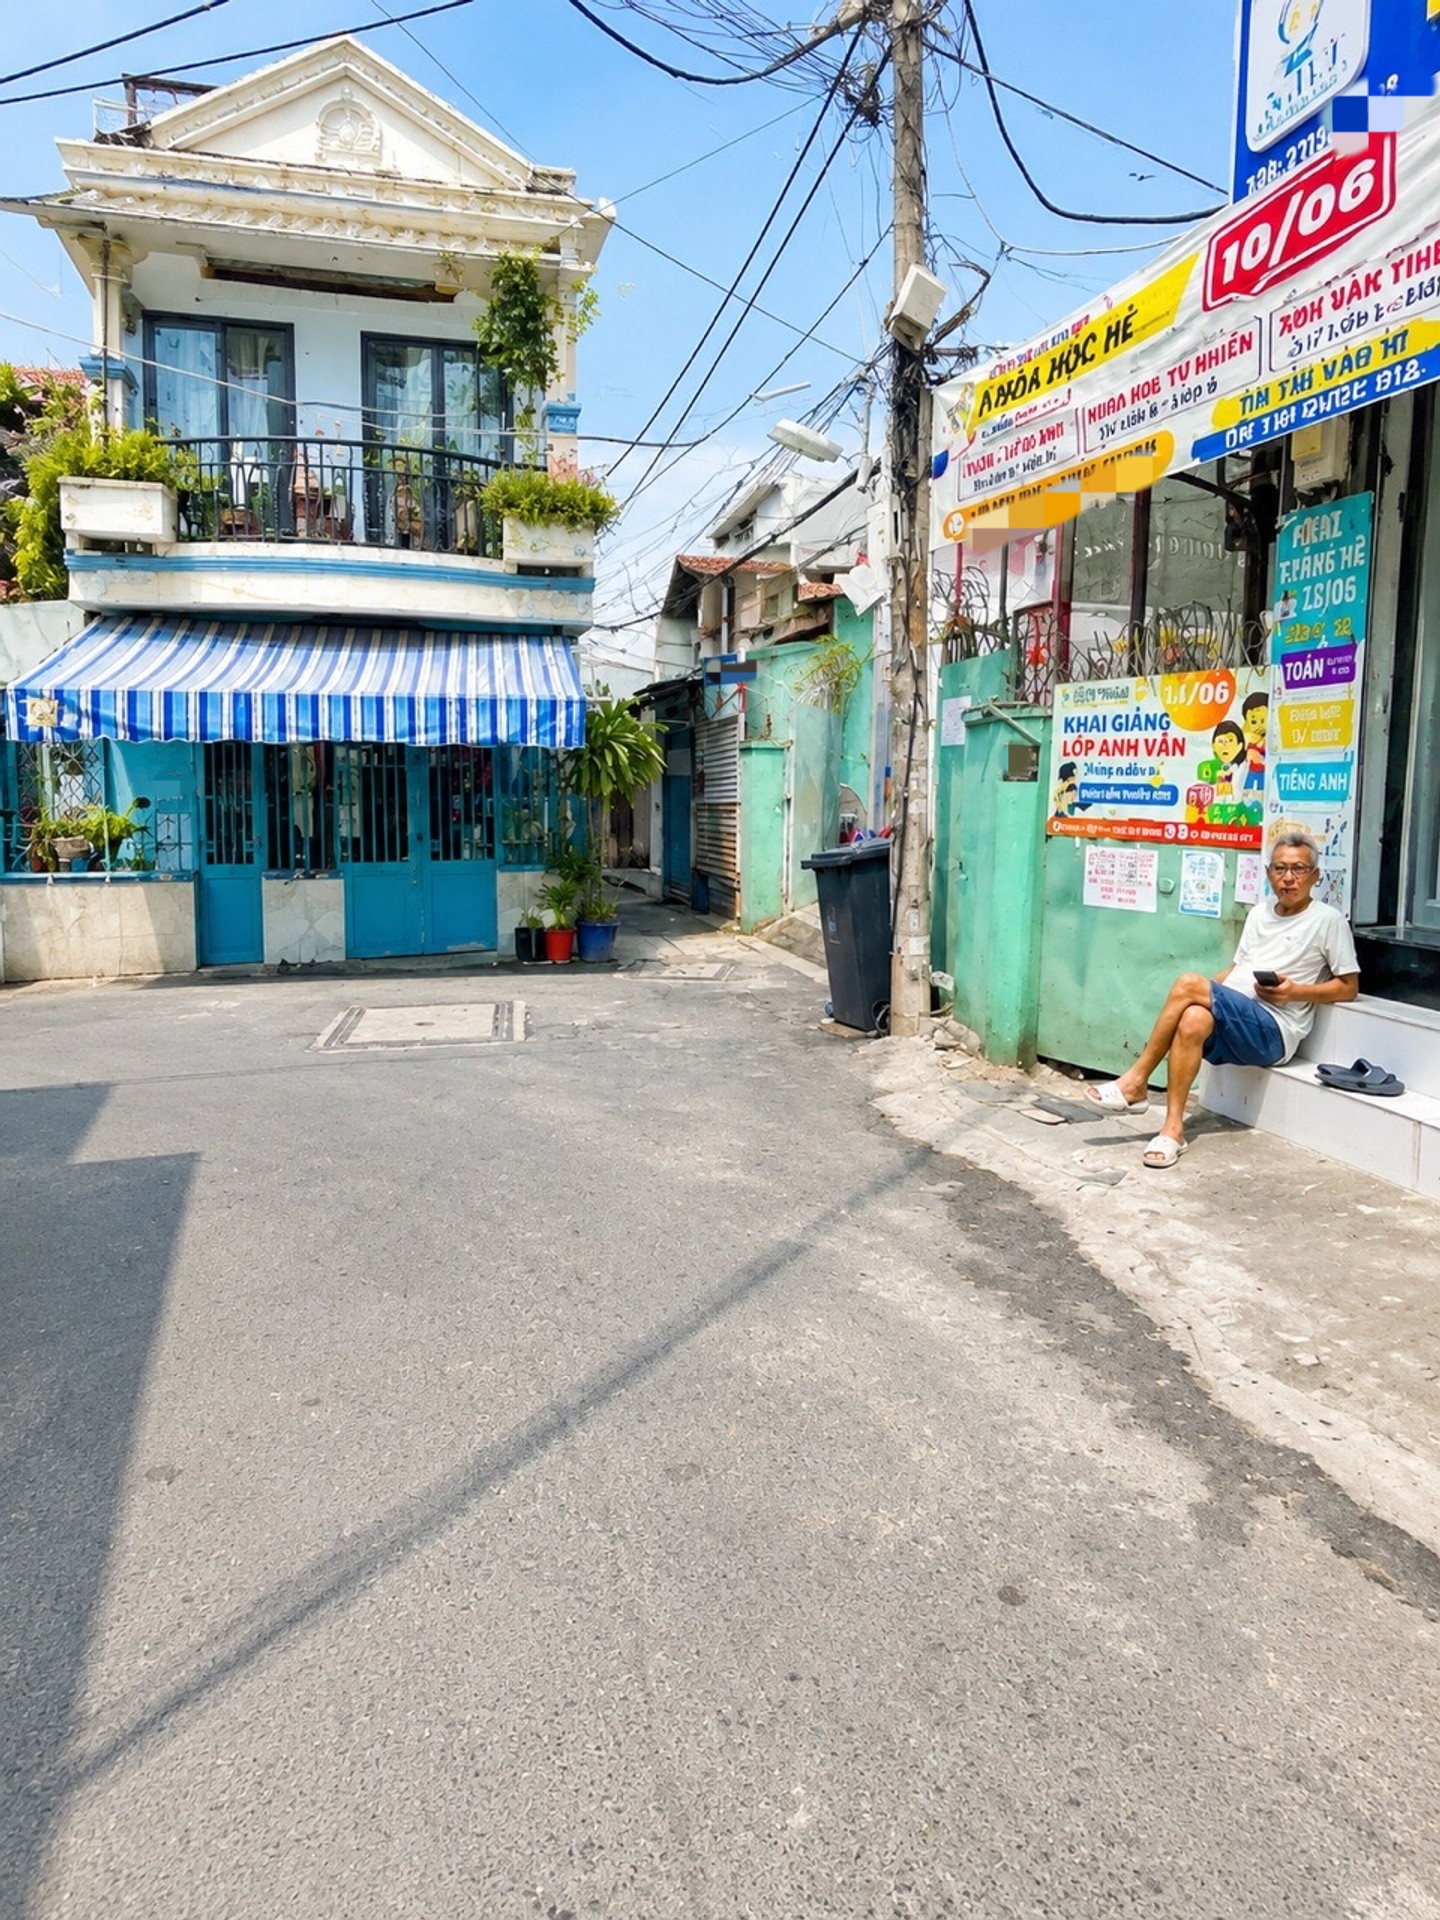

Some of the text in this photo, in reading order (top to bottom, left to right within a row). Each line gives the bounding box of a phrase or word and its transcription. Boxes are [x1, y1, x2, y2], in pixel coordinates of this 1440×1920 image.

[1221, 157, 1377, 284] 10/06
[1284, 653, 1325, 681] TOÁN
[1063, 714, 1107, 734] KHAI
[1098, 737, 1140, 758] ANH
[1318, 772, 1348, 792] ANH
